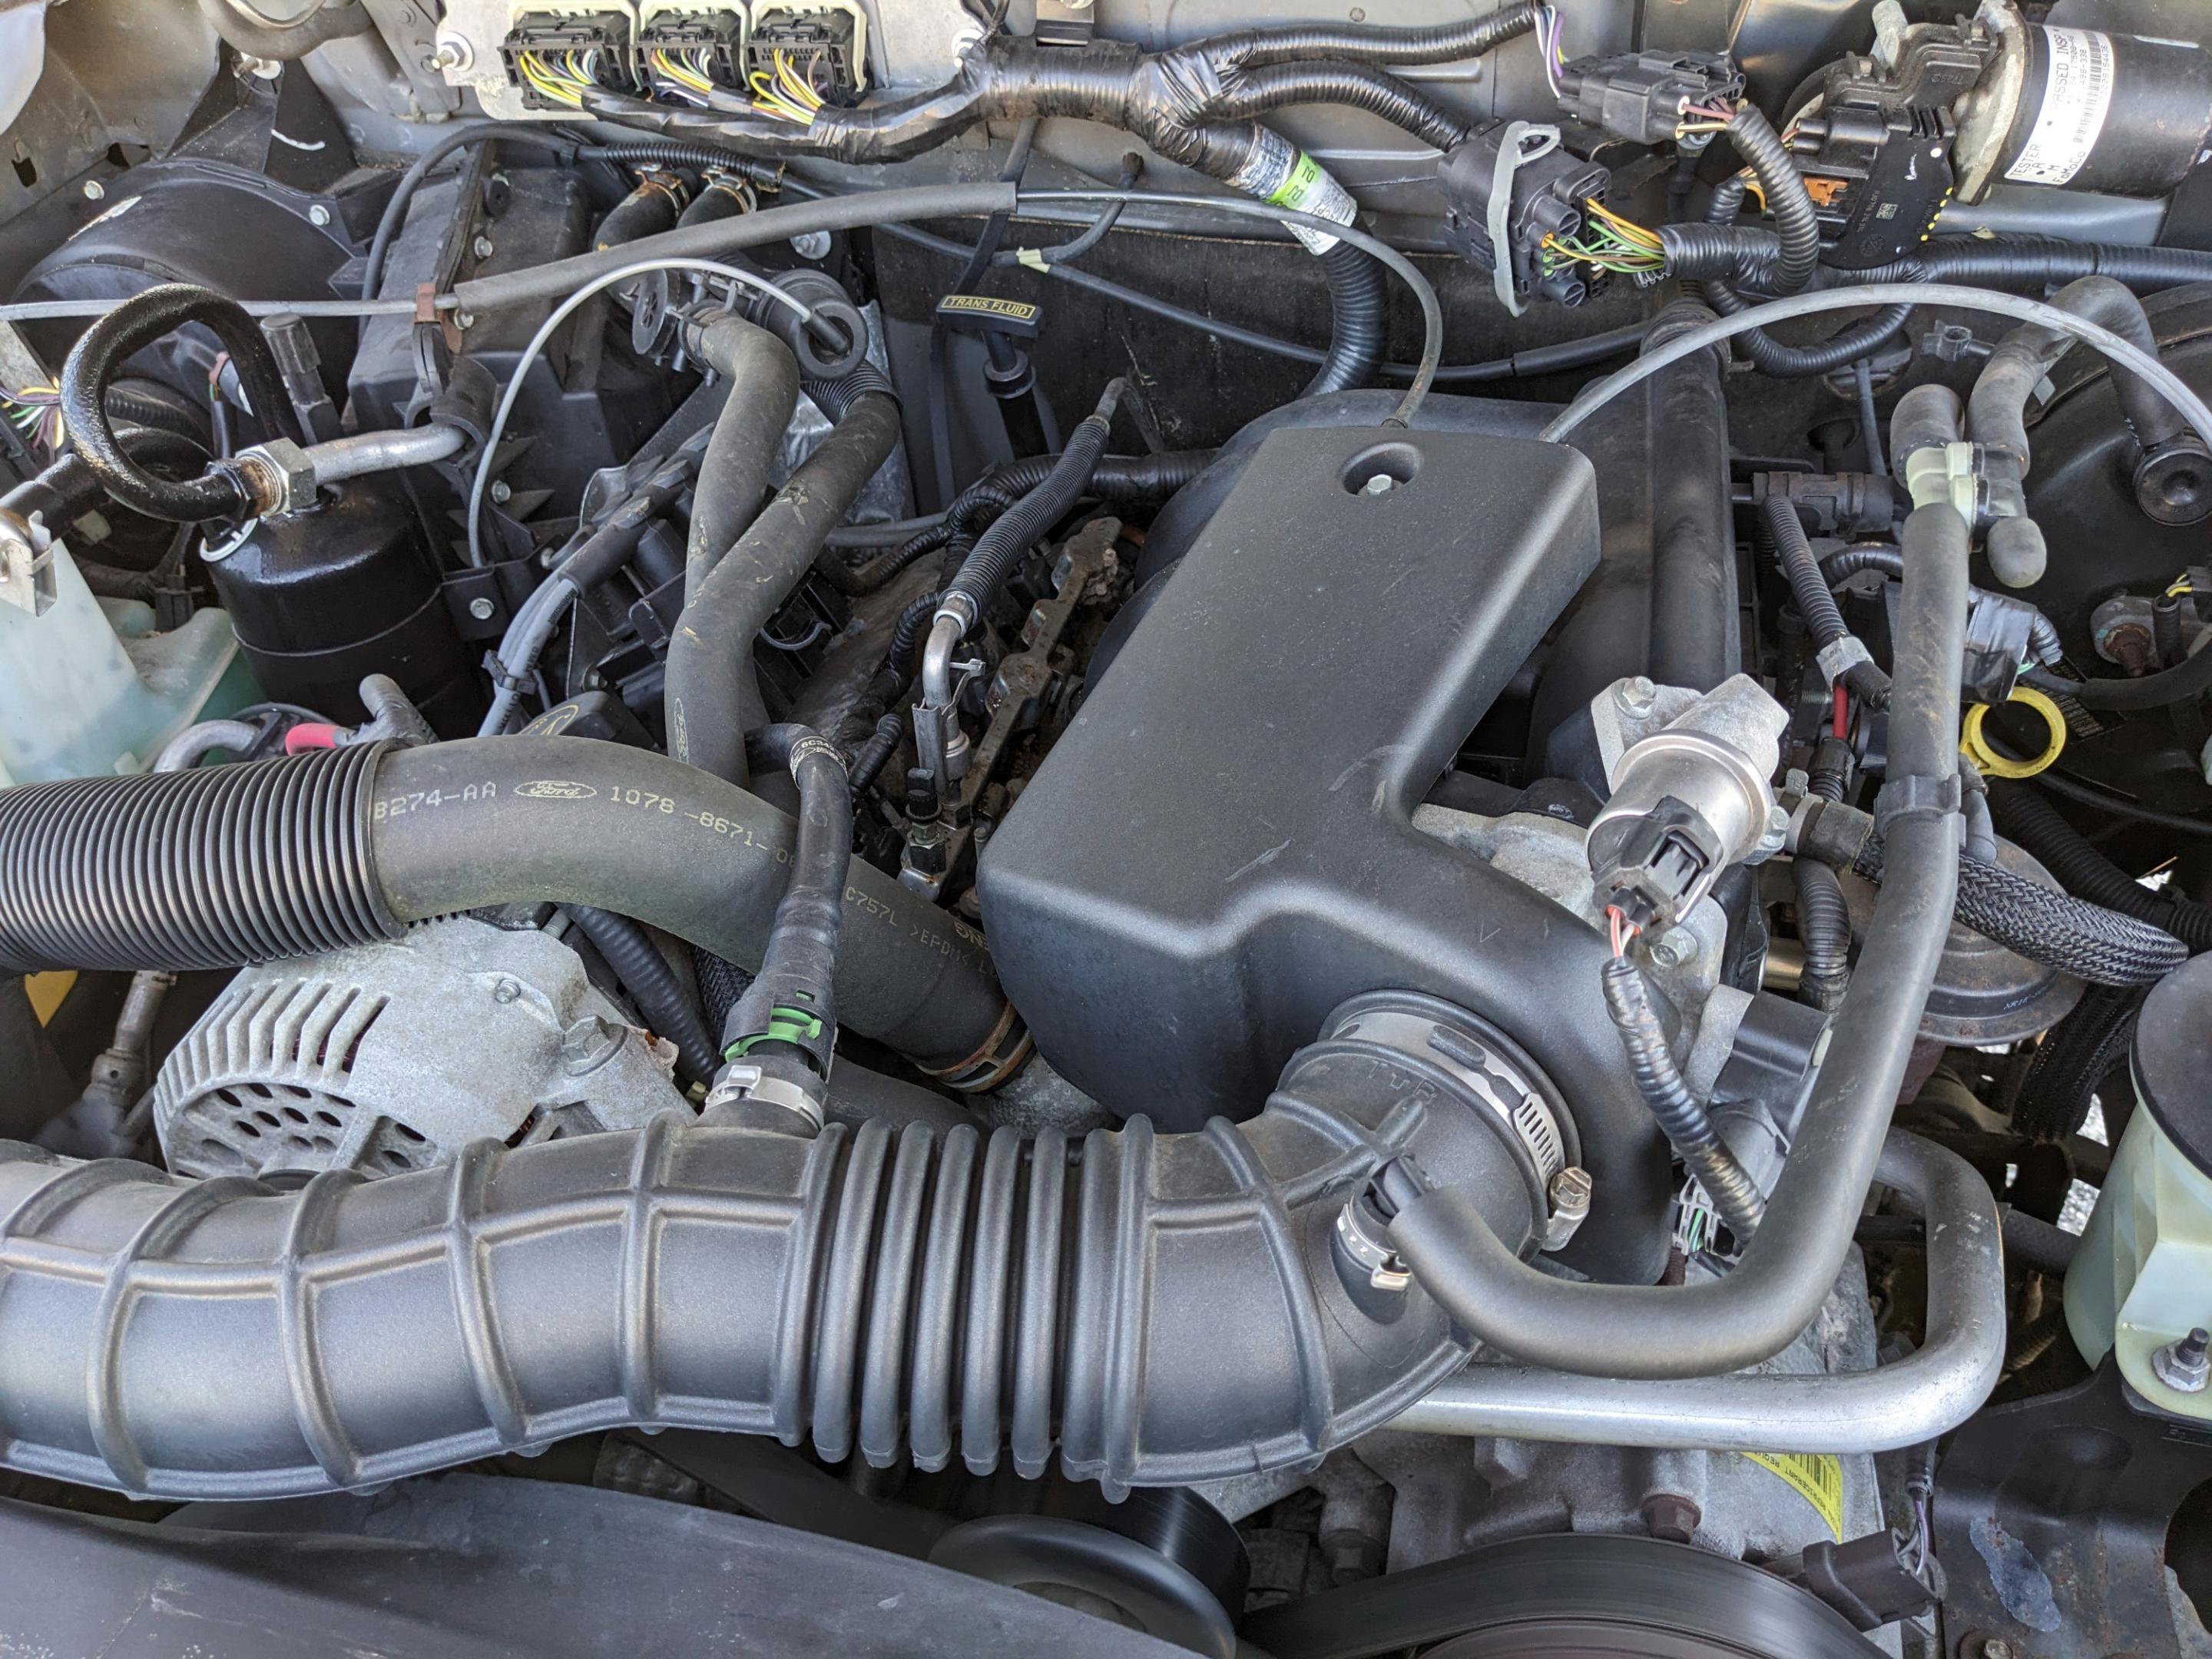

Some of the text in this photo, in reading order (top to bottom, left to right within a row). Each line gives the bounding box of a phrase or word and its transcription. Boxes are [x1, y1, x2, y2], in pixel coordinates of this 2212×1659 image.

[2051, 62, 2069, 111] PASSED
[2009, 143, 2041, 177] TESTER
[2051, 151, 2086, 183] FoMoCo
[949, 297, 1028, 316] TRANS FLUID
[610, 786, 676, 814] 1078
